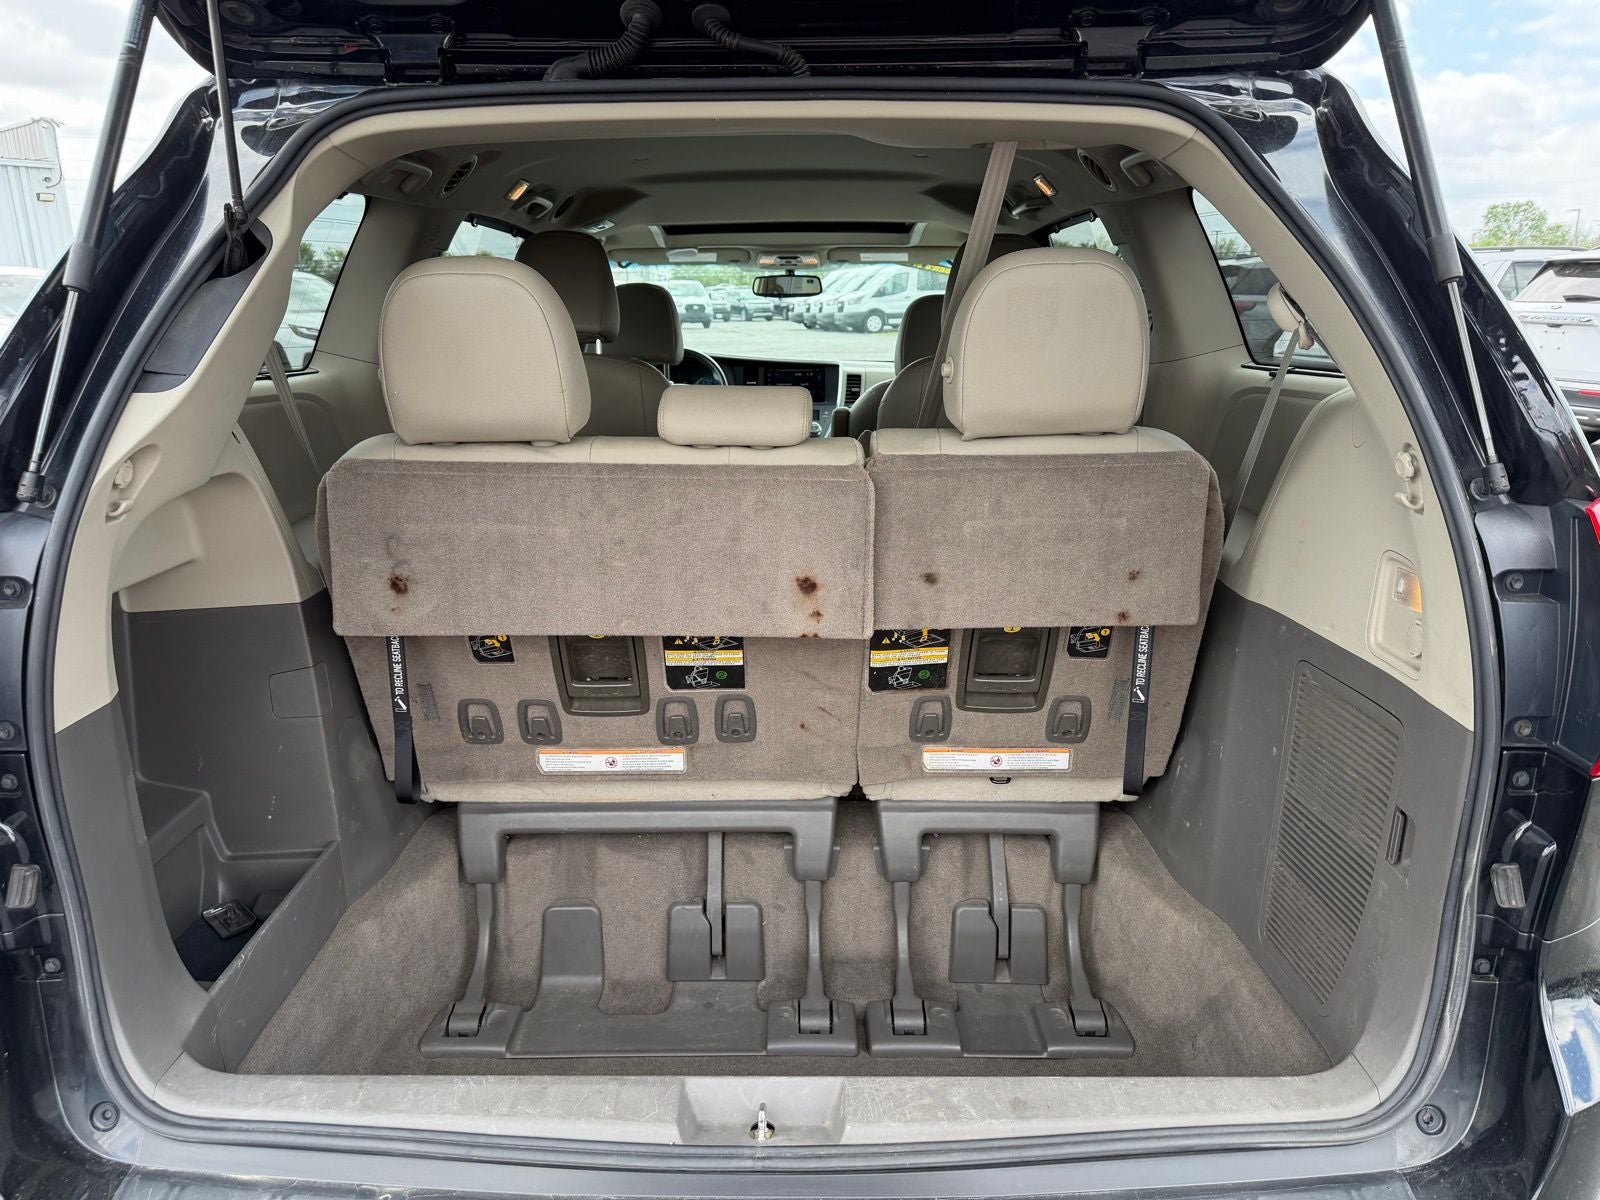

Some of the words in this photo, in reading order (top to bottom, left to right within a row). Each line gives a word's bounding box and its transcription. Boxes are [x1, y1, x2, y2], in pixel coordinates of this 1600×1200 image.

[391, 636, 401, 662] SEATBAC
[1139, 626, 1149, 653] SEATBAC
[393, 663, 403, 687] RECLINE
[1137, 653, 1147, 677] RECLINE
[395, 687, 404, 695] TO
